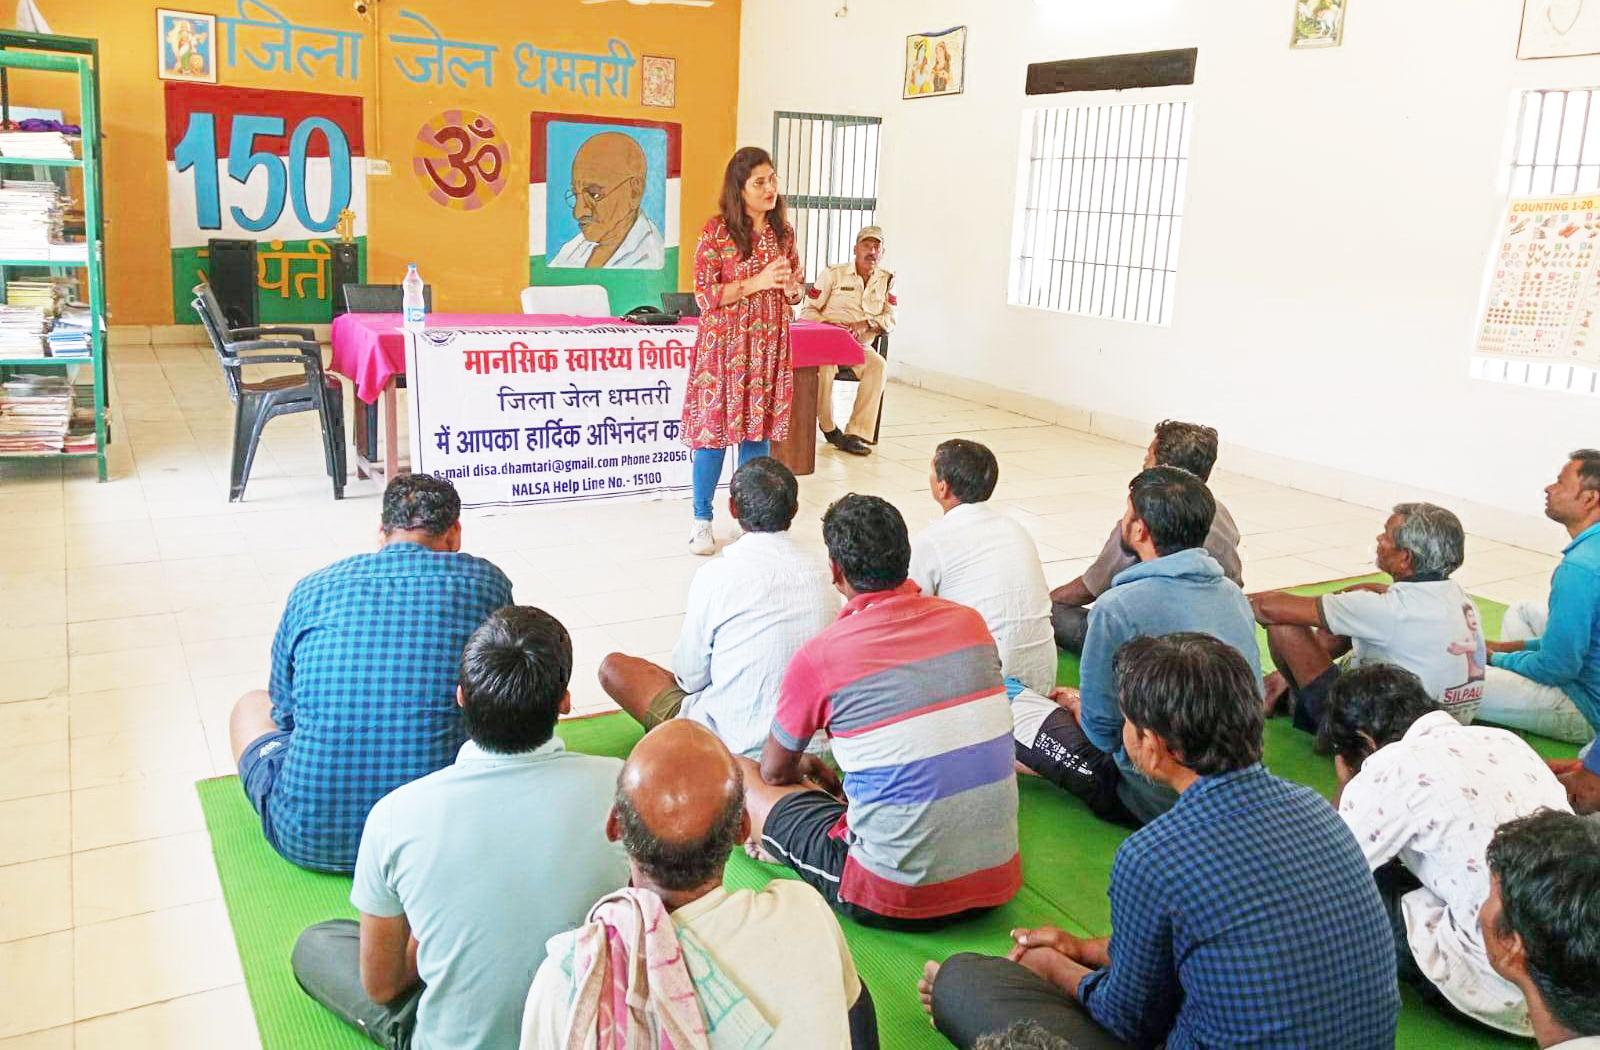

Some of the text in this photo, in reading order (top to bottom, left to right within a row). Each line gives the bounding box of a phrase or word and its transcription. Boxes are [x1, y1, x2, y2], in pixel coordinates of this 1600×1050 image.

[217, 0, 636, 98] जिला जेल धमतरी
[174, 112, 353, 232] 150
[1513, 200, 1593, 212] COUNTING 1-20
[463, 341, 558, 374] मानसिक
[564, 346, 633, 371] स्वास्थ्य
[497, 380, 671, 411] जिला जेल धमतरी
[434, 424, 450, 455] में
[456, 428, 520, 453] आपका
[525, 418, 582, 451] हार्दिक
[587, 416, 659, 445] अभिनंदन
[434, 464, 470, 479] e-mail
[473, 456, 618, 477] disa.dhamtari@gmail.com
[621, 453, 650, 467] Phone
[652, 450, 687, 463] 232056
[512, 482, 550, 496] NALSA
[553, 478, 580, 494] Help
[582, 476, 605, 491] Line
[633, 472, 662, 486] 15100
